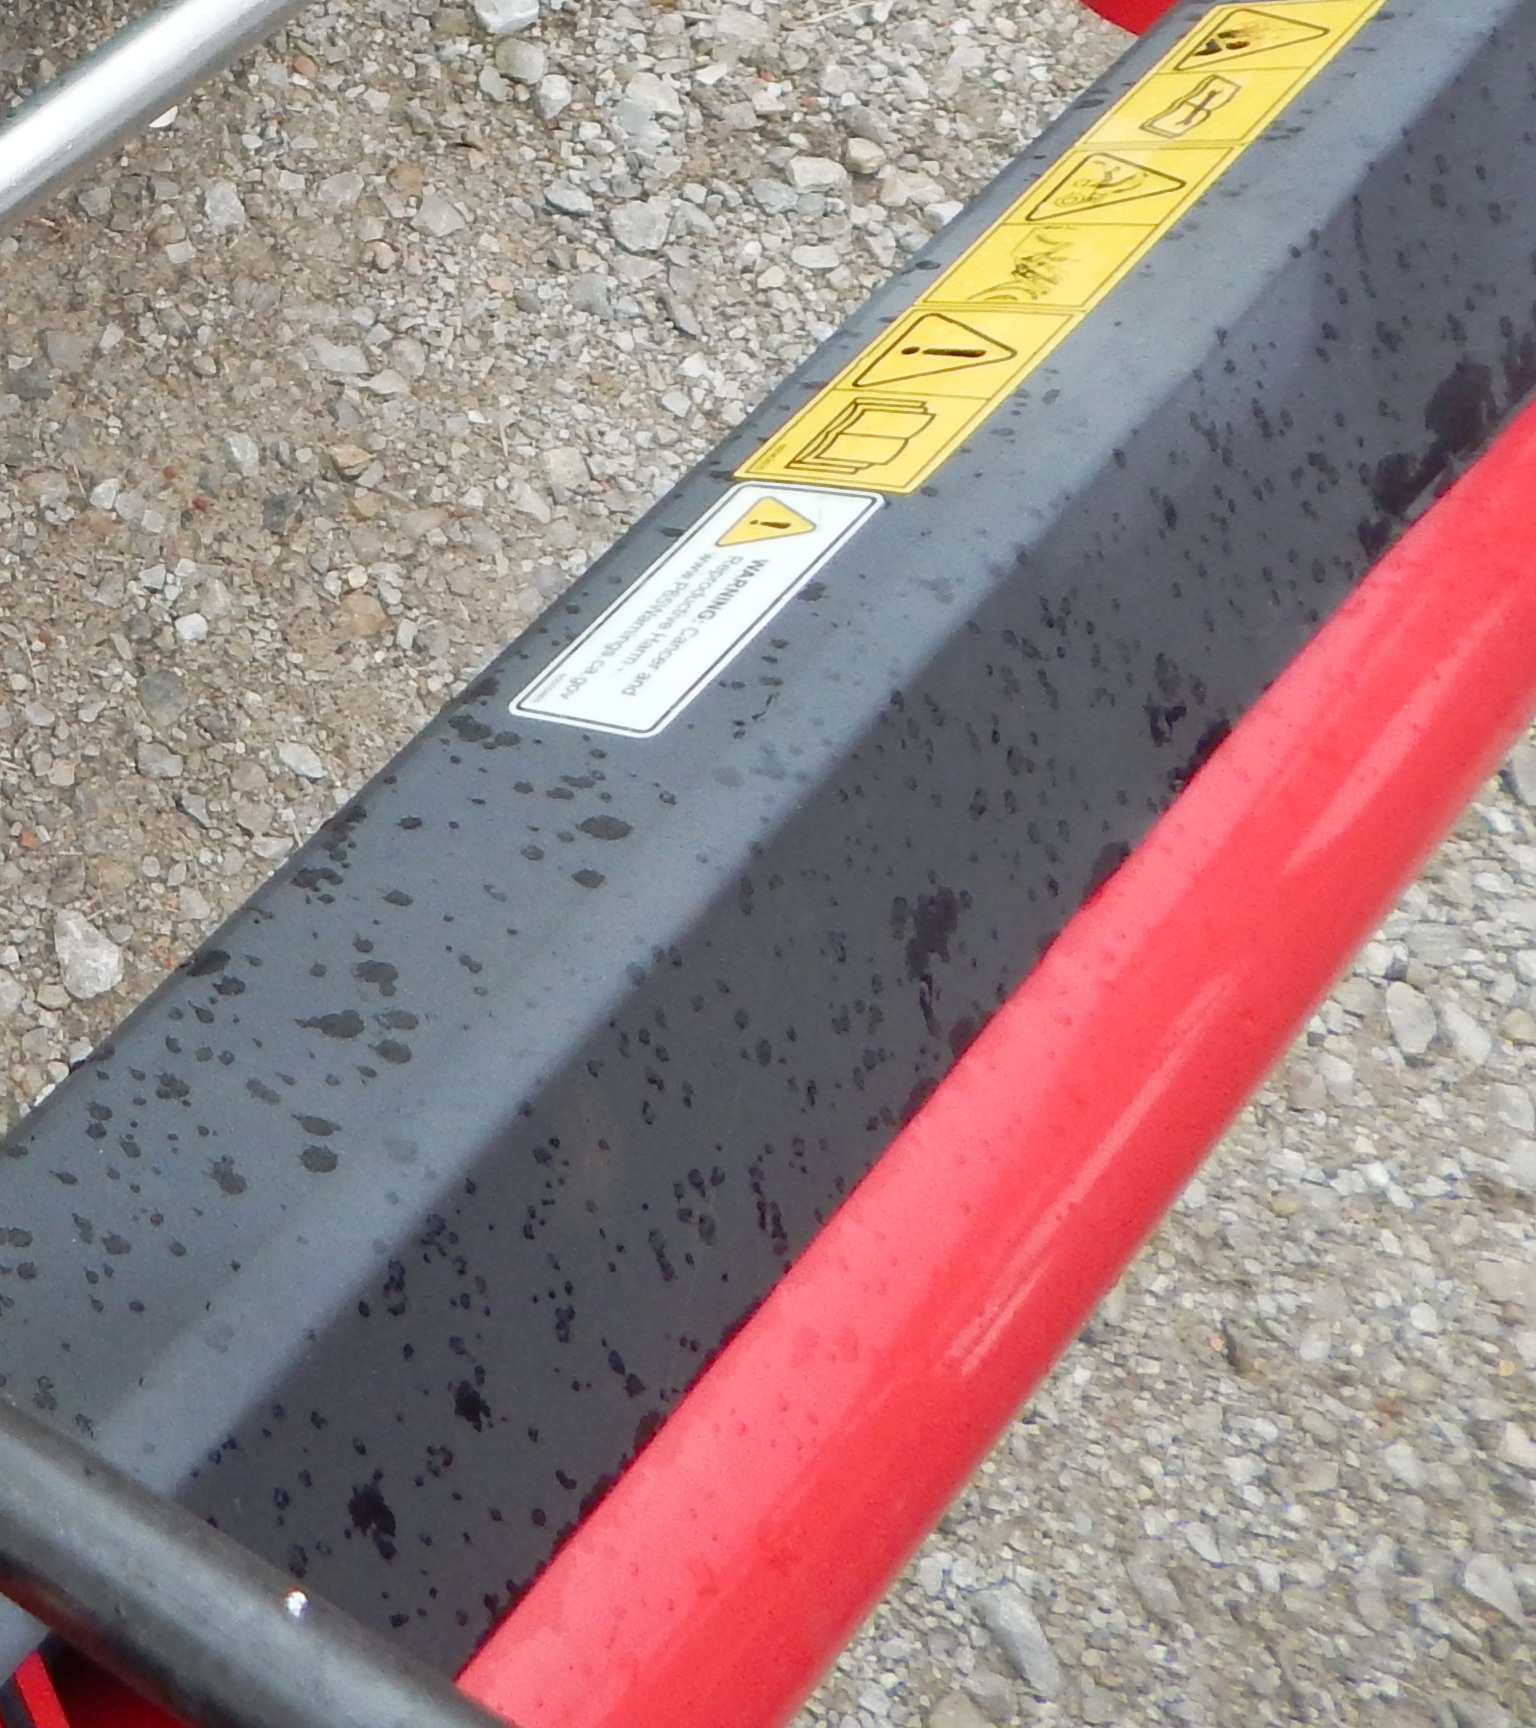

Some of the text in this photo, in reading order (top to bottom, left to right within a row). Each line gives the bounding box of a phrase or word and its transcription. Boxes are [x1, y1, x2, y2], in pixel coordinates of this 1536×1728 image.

[655, 554, 742, 629] Reproductive
[690, 557, 769, 625] WARNING:
[620, 631, 666, 665] Harm
[643, 626, 701, 672] Cancer
[619, 671, 655, 696] and
